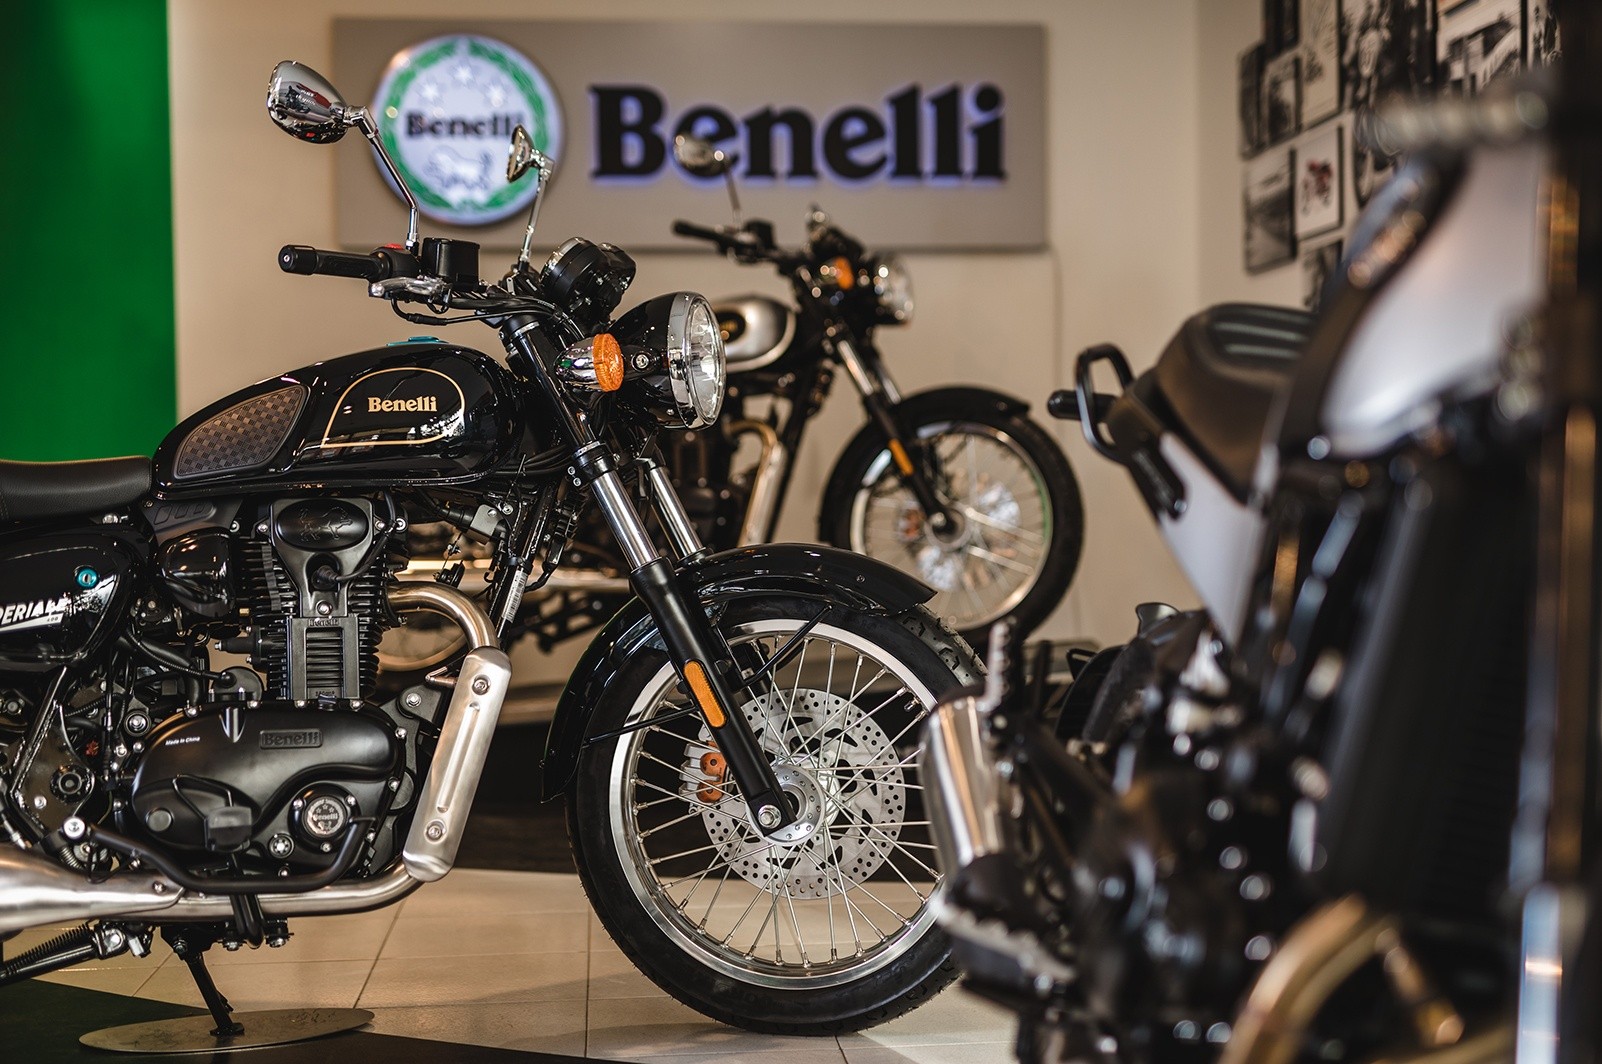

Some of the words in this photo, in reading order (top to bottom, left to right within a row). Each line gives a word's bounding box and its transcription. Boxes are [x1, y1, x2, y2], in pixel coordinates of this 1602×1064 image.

[588, 82, 1006, 181] Benelli
[367, 396, 437, 412] Benelli
[264, 731, 319, 746] Benelli
